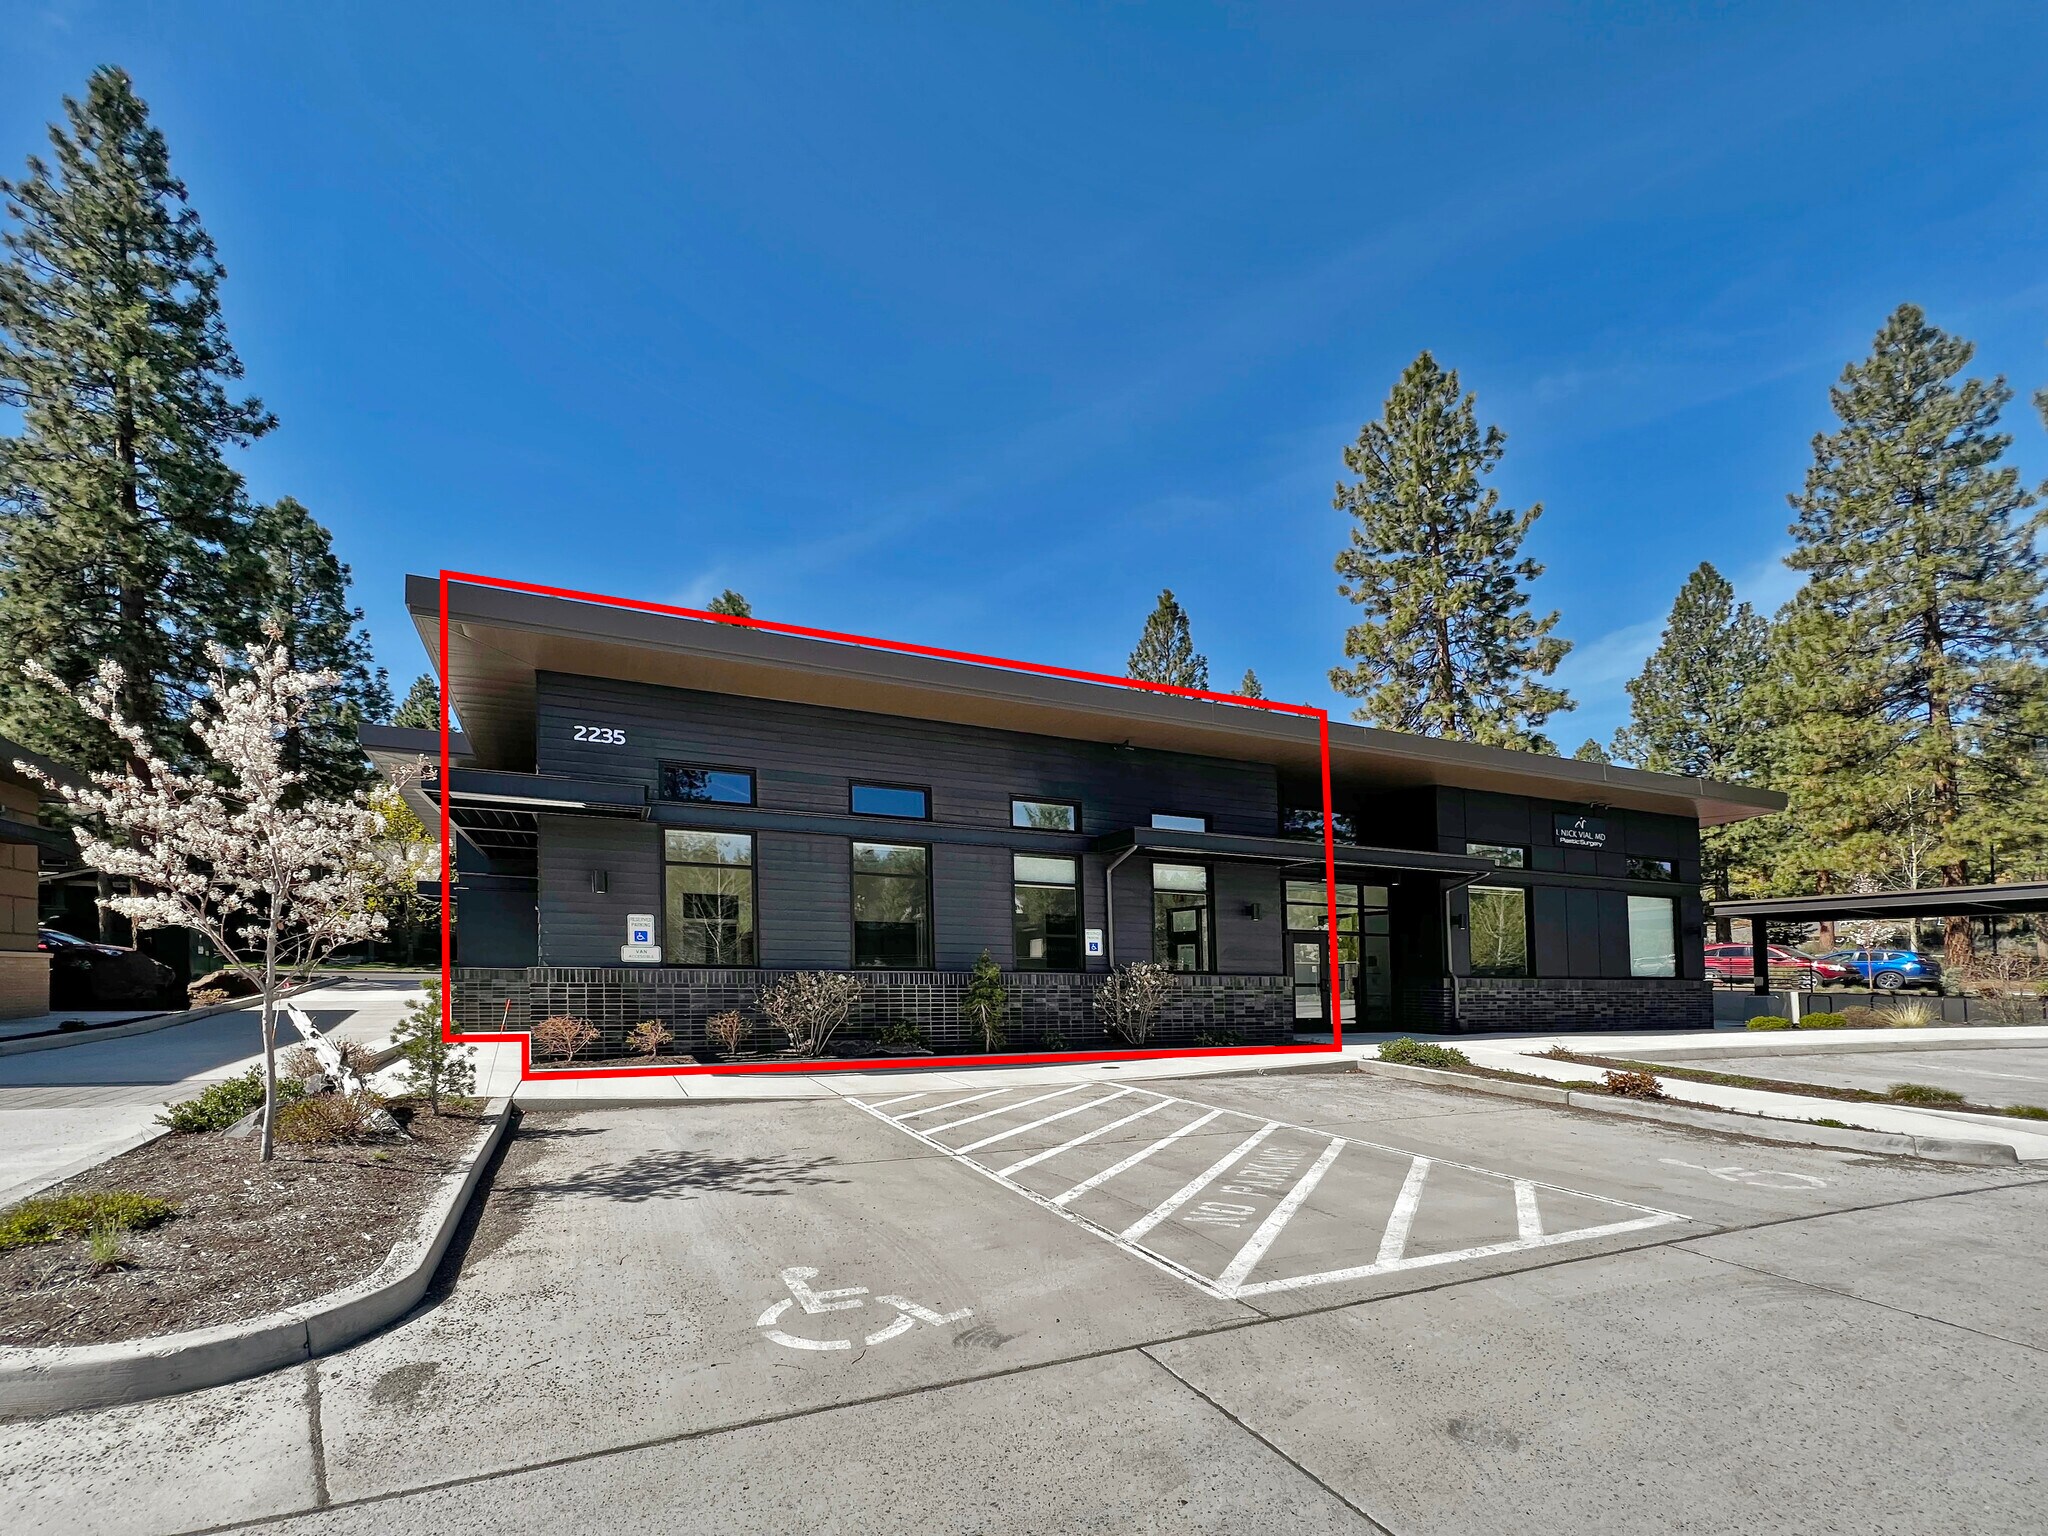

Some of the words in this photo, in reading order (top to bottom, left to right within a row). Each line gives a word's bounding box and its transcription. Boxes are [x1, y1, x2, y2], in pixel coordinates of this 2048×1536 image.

[573, 725, 626, 745] 2235
[1560, 829, 1577, 838] NICK
[1578, 831, 1593, 840] VIAL
[1594, 833, 1606, 841] MD
[1219, 1147, 1308, 1198] PARKING
[1182, 1201, 1257, 1228] NO
